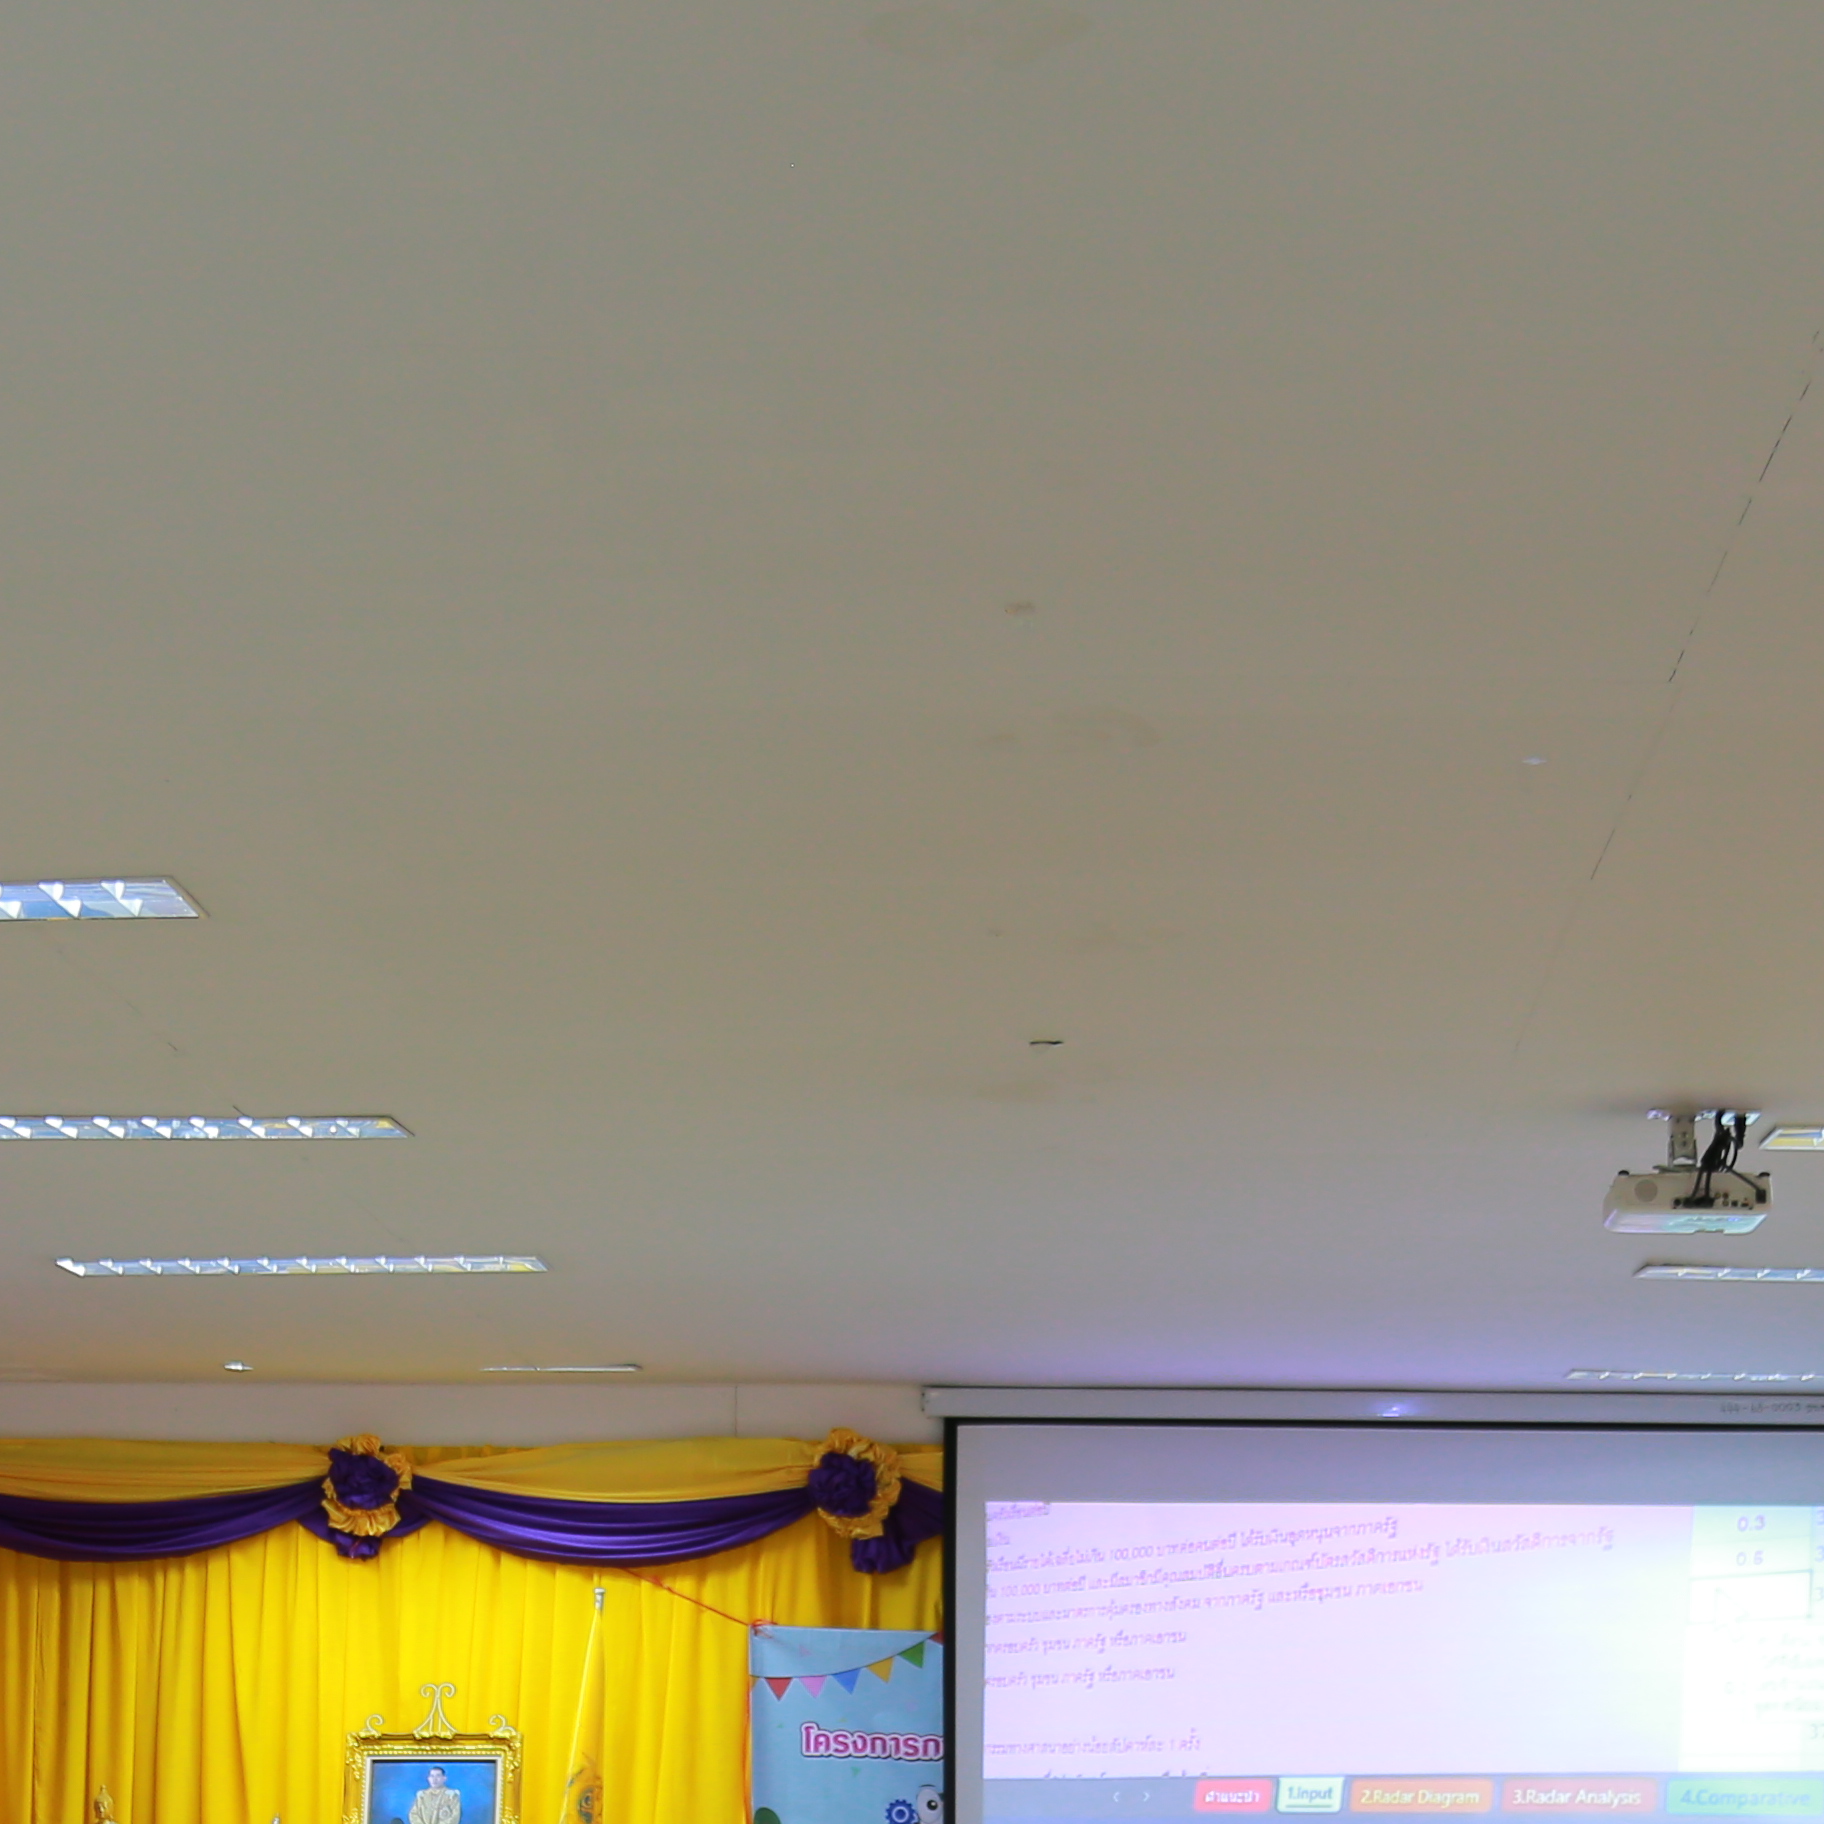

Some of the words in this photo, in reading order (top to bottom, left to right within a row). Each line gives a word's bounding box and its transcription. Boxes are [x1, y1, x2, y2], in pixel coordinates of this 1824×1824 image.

[1361, 1789, 1413, 1805] 2.Radar
[1418, 1789, 1479, 1808] Diagram
[1512, 1789, 1572, 1805] 3.Radar
[1576, 1789, 1641, 1808] Analysis
